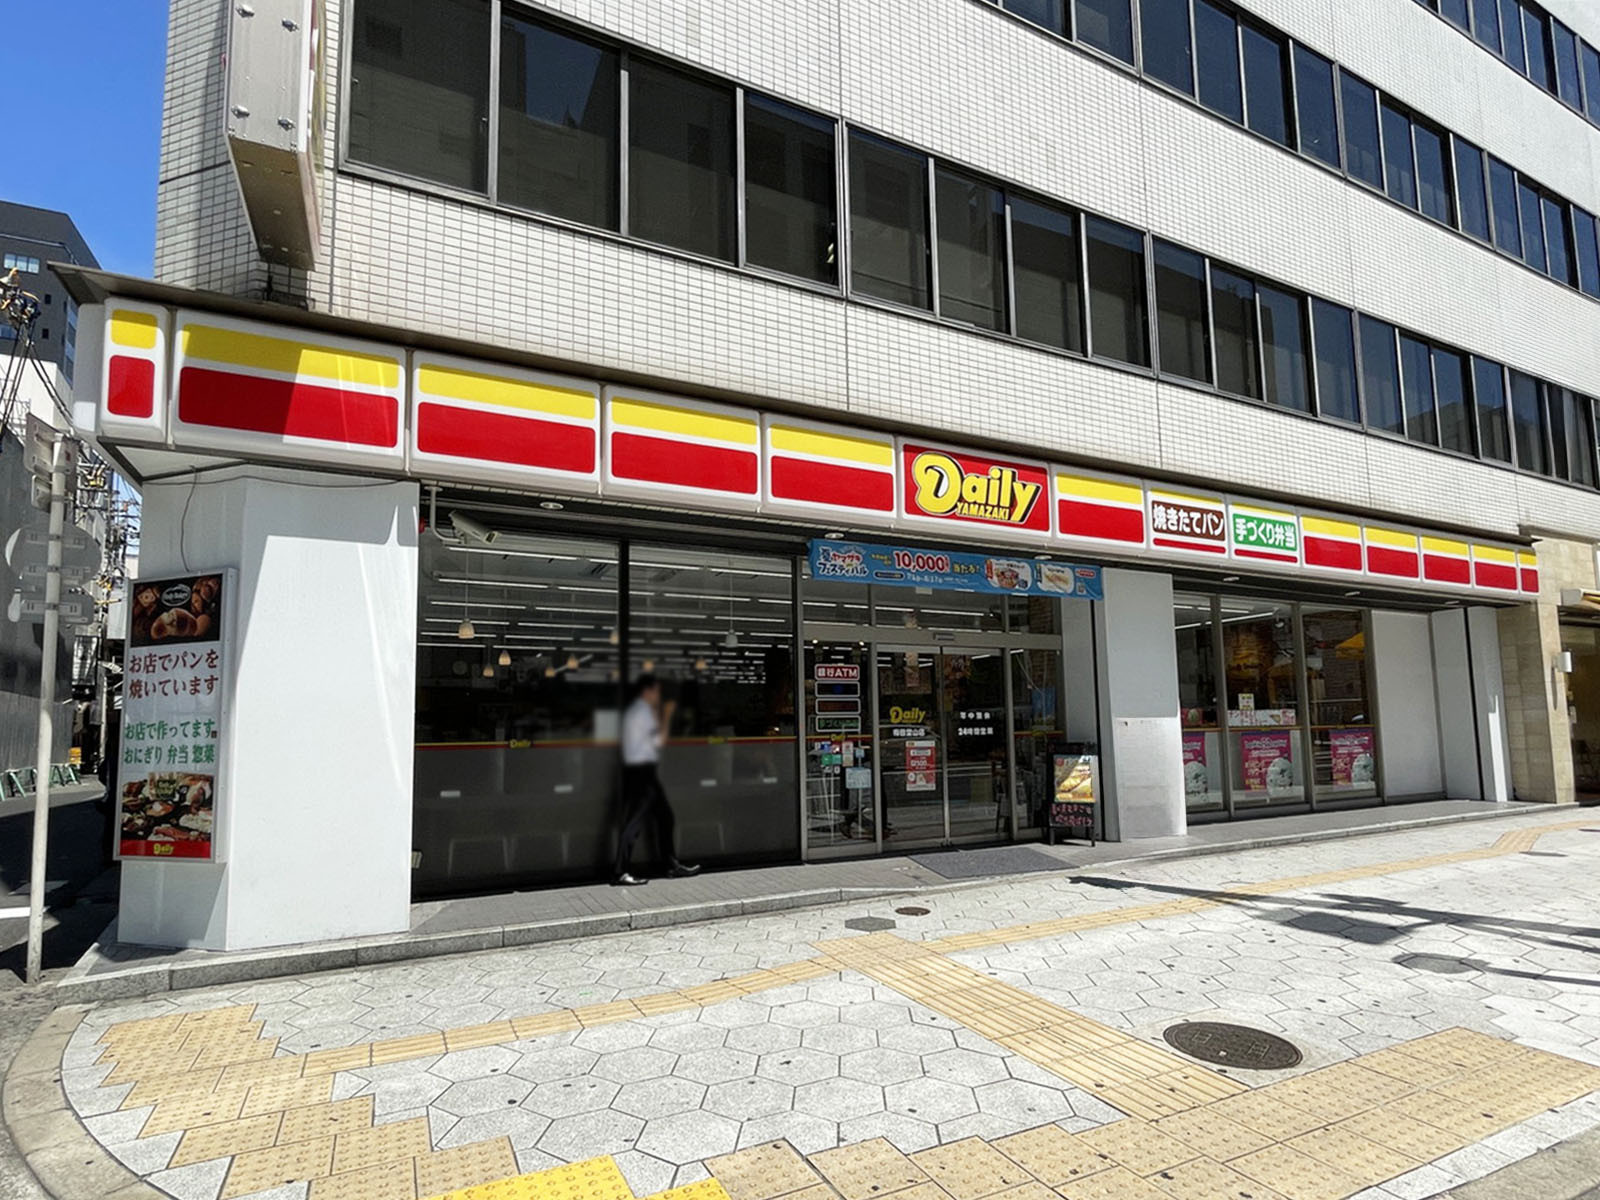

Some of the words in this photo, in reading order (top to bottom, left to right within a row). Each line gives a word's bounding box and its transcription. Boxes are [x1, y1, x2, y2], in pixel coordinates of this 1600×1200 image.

[913, 451, 1042, 524] Daily
[956, 501, 1010, 521] YAMAZAKI
[1153, 504, 1224, 536] 焼きたてパン
[1235, 518, 1296, 548] 手づくり弁当
[894, 551, 945, 572] 10,000
[129, 649, 219, 674] お店でパンを
[129, 675, 219, 699] 焼いています
[889, 706, 926, 723] Daily
[124, 719, 215, 740] お店で作ってます
[124, 746, 162, 764] おにぎり
[168, 744, 188, 764] 弁当
[192, 744, 215, 764] 惣菜
